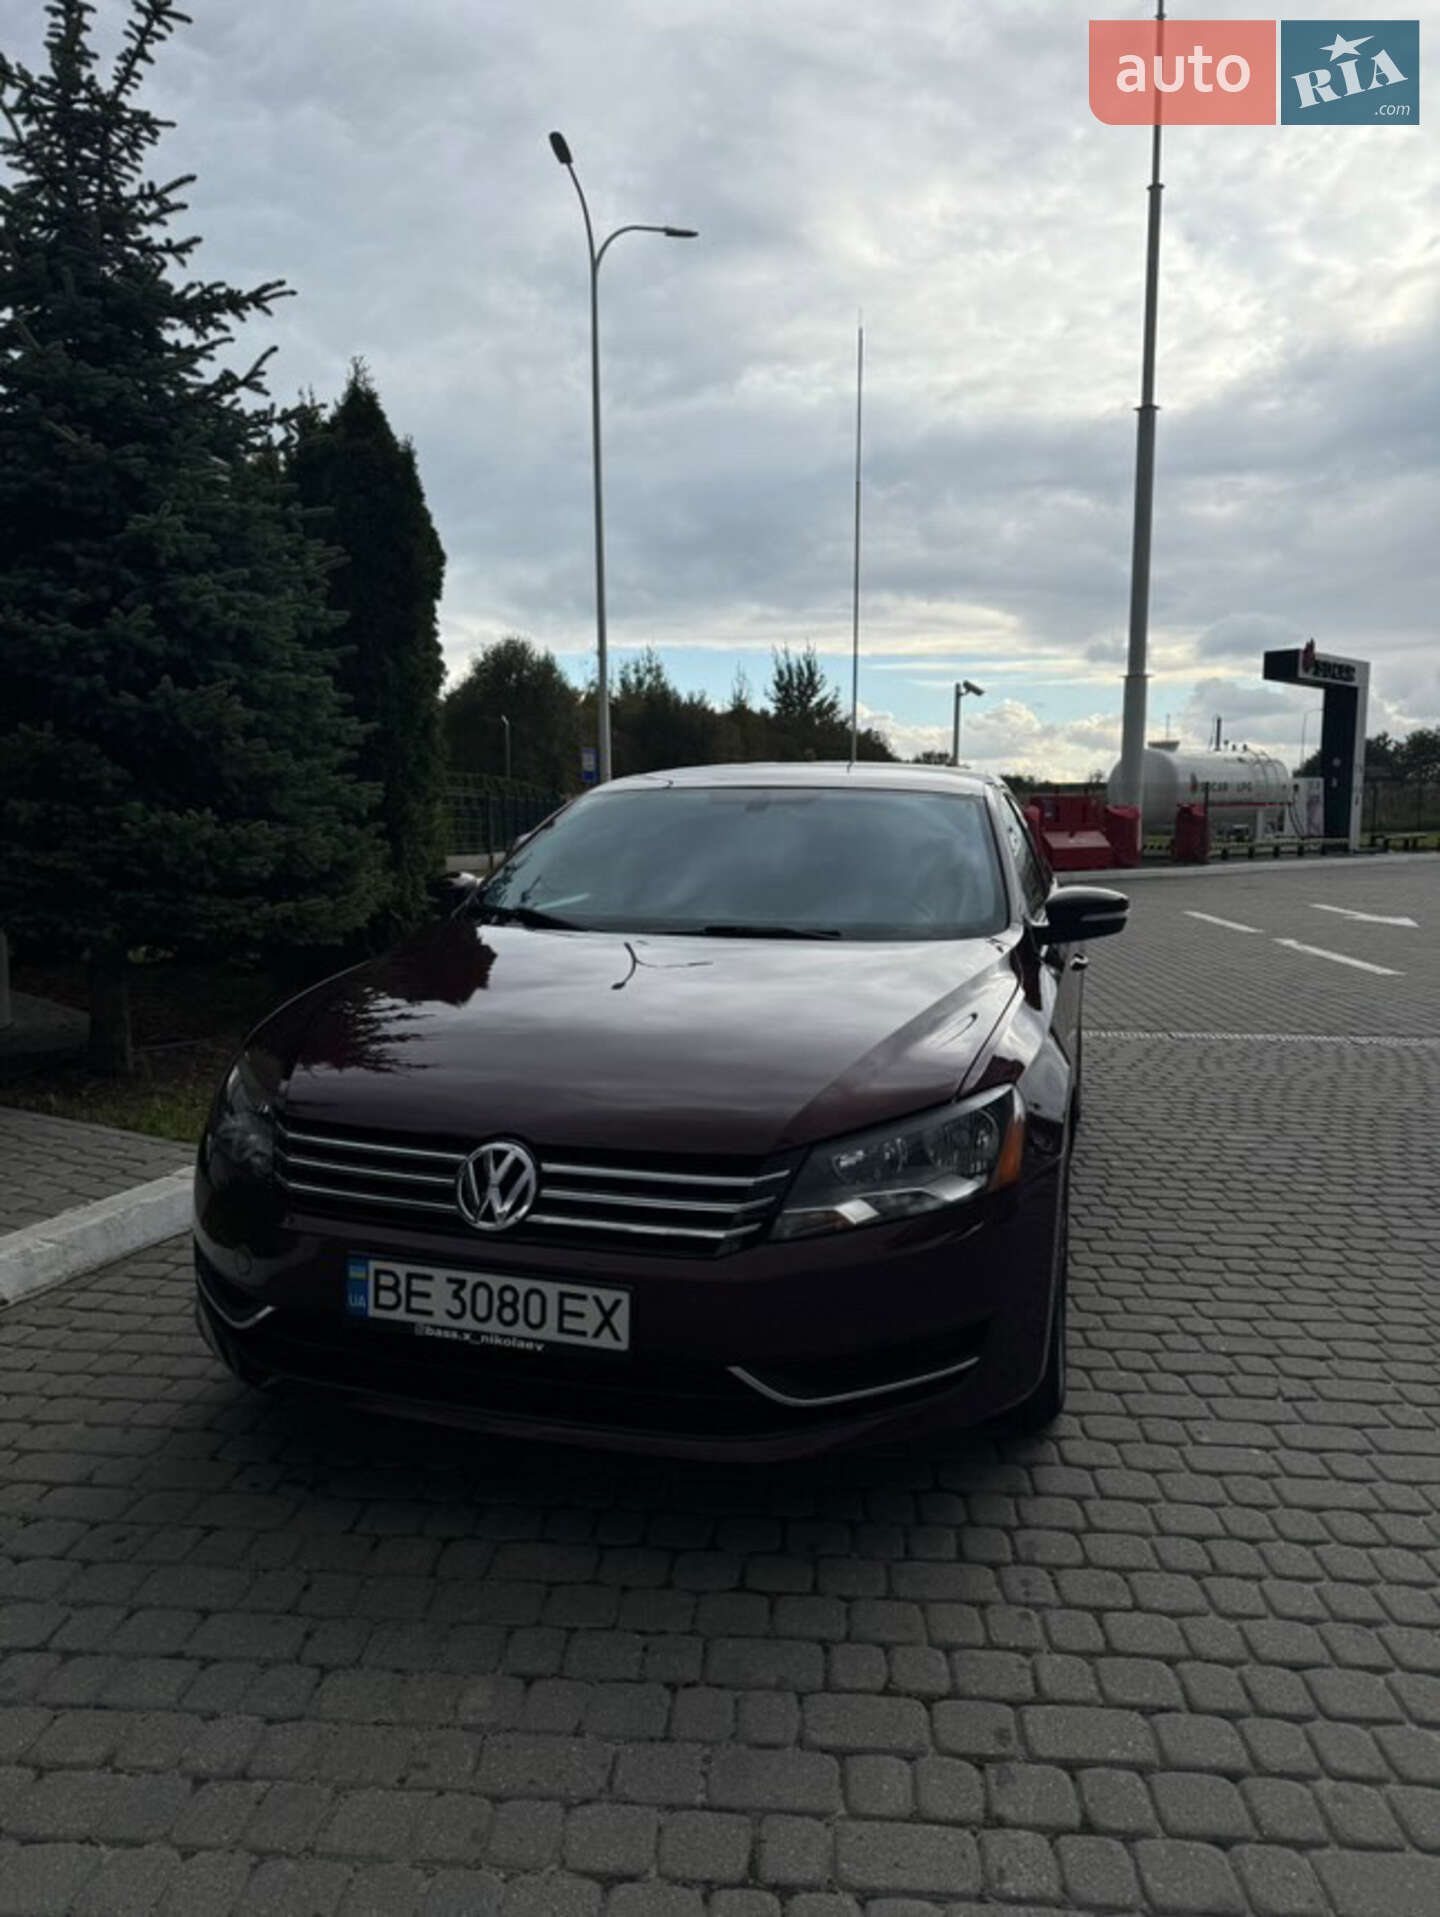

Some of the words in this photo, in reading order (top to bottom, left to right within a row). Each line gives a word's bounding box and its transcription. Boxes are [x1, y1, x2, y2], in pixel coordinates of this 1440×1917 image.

[348, 1293, 367, 1309] UA
[373, 1268, 435, 1318] BE
[445, 1277, 547, 1331] 3080
[557, 1291, 623, 1343] EX
